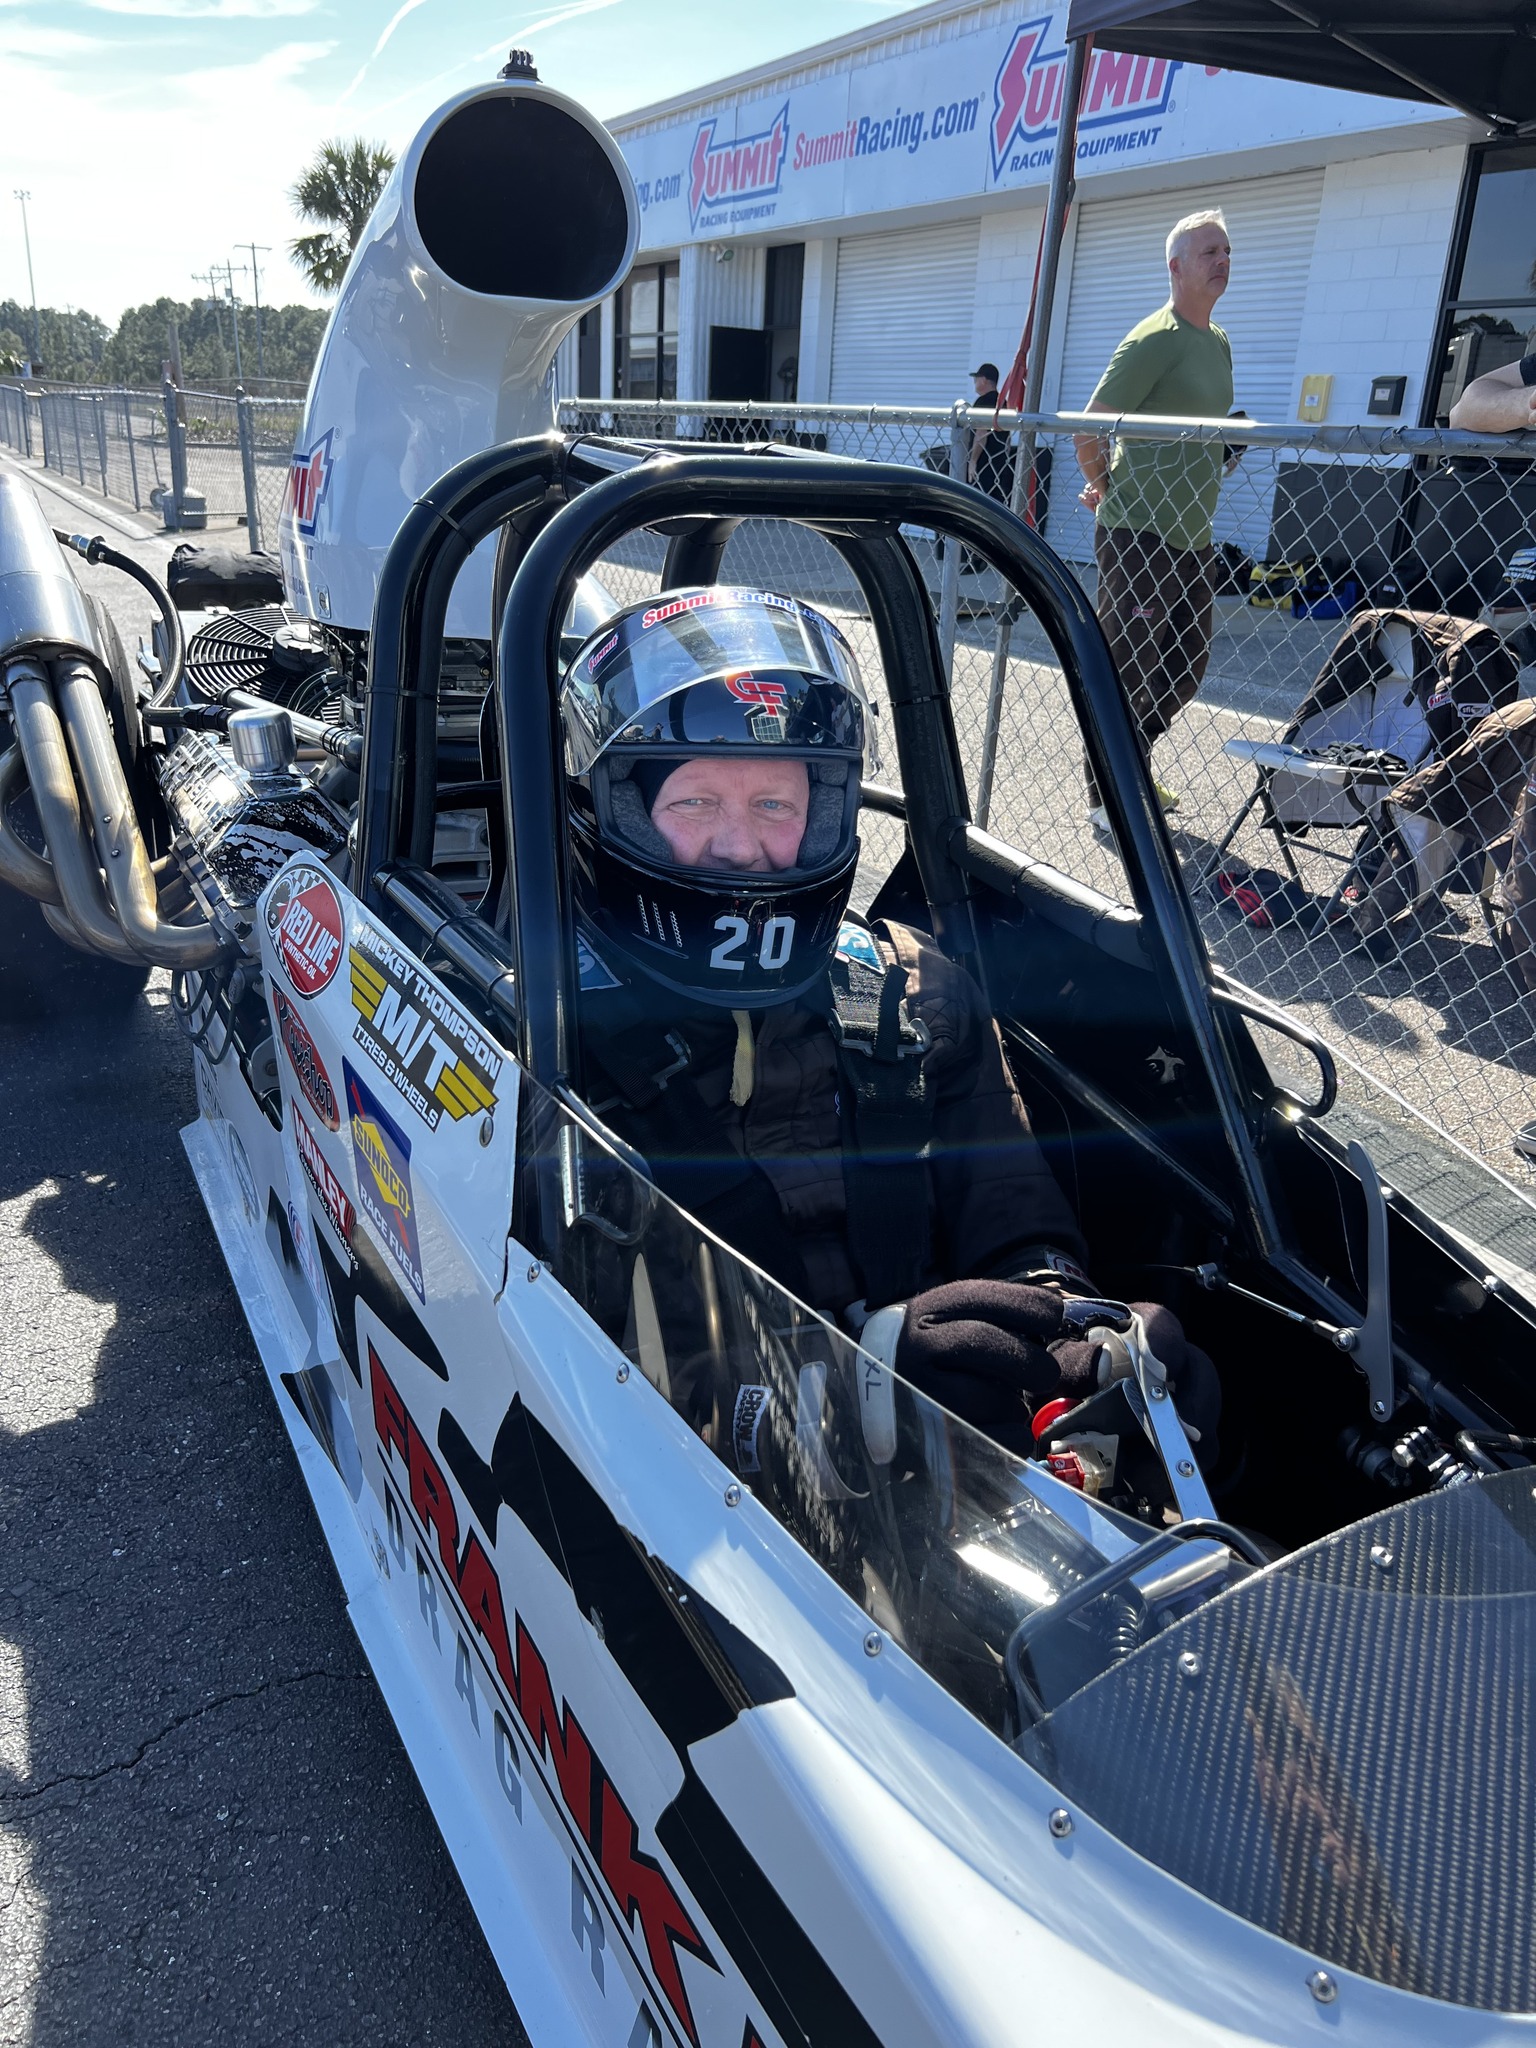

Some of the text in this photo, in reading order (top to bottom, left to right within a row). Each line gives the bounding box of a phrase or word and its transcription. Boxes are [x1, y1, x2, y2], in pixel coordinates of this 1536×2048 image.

[793, 97, 979, 171] SummitRacing.com
[1010, 126, 1163, 172] RACIN QUIPMENT
[700, 203, 777, 229] RACING EQUIPMENT
[282, 899, 314, 946] RED
[303, 921, 340, 974] LINE
[283, 938, 317, 980] SYNTHETIC OIL
[709, 914, 797, 971] 20
[360, 927, 501, 1080] MICKEY THOMPSON
[355, 1024, 387, 1067] TIRES
[393, 1066, 439, 1129] WHEELS
[293, 1104, 347, 1228] MANLEY
[355, 1122, 408, 1209] SUNOCO
[360, 1183, 423, 1294] RACE FUELS
[739, 1388, 766, 1442] CROW
[367, 1337, 722, 2047] FRANK
